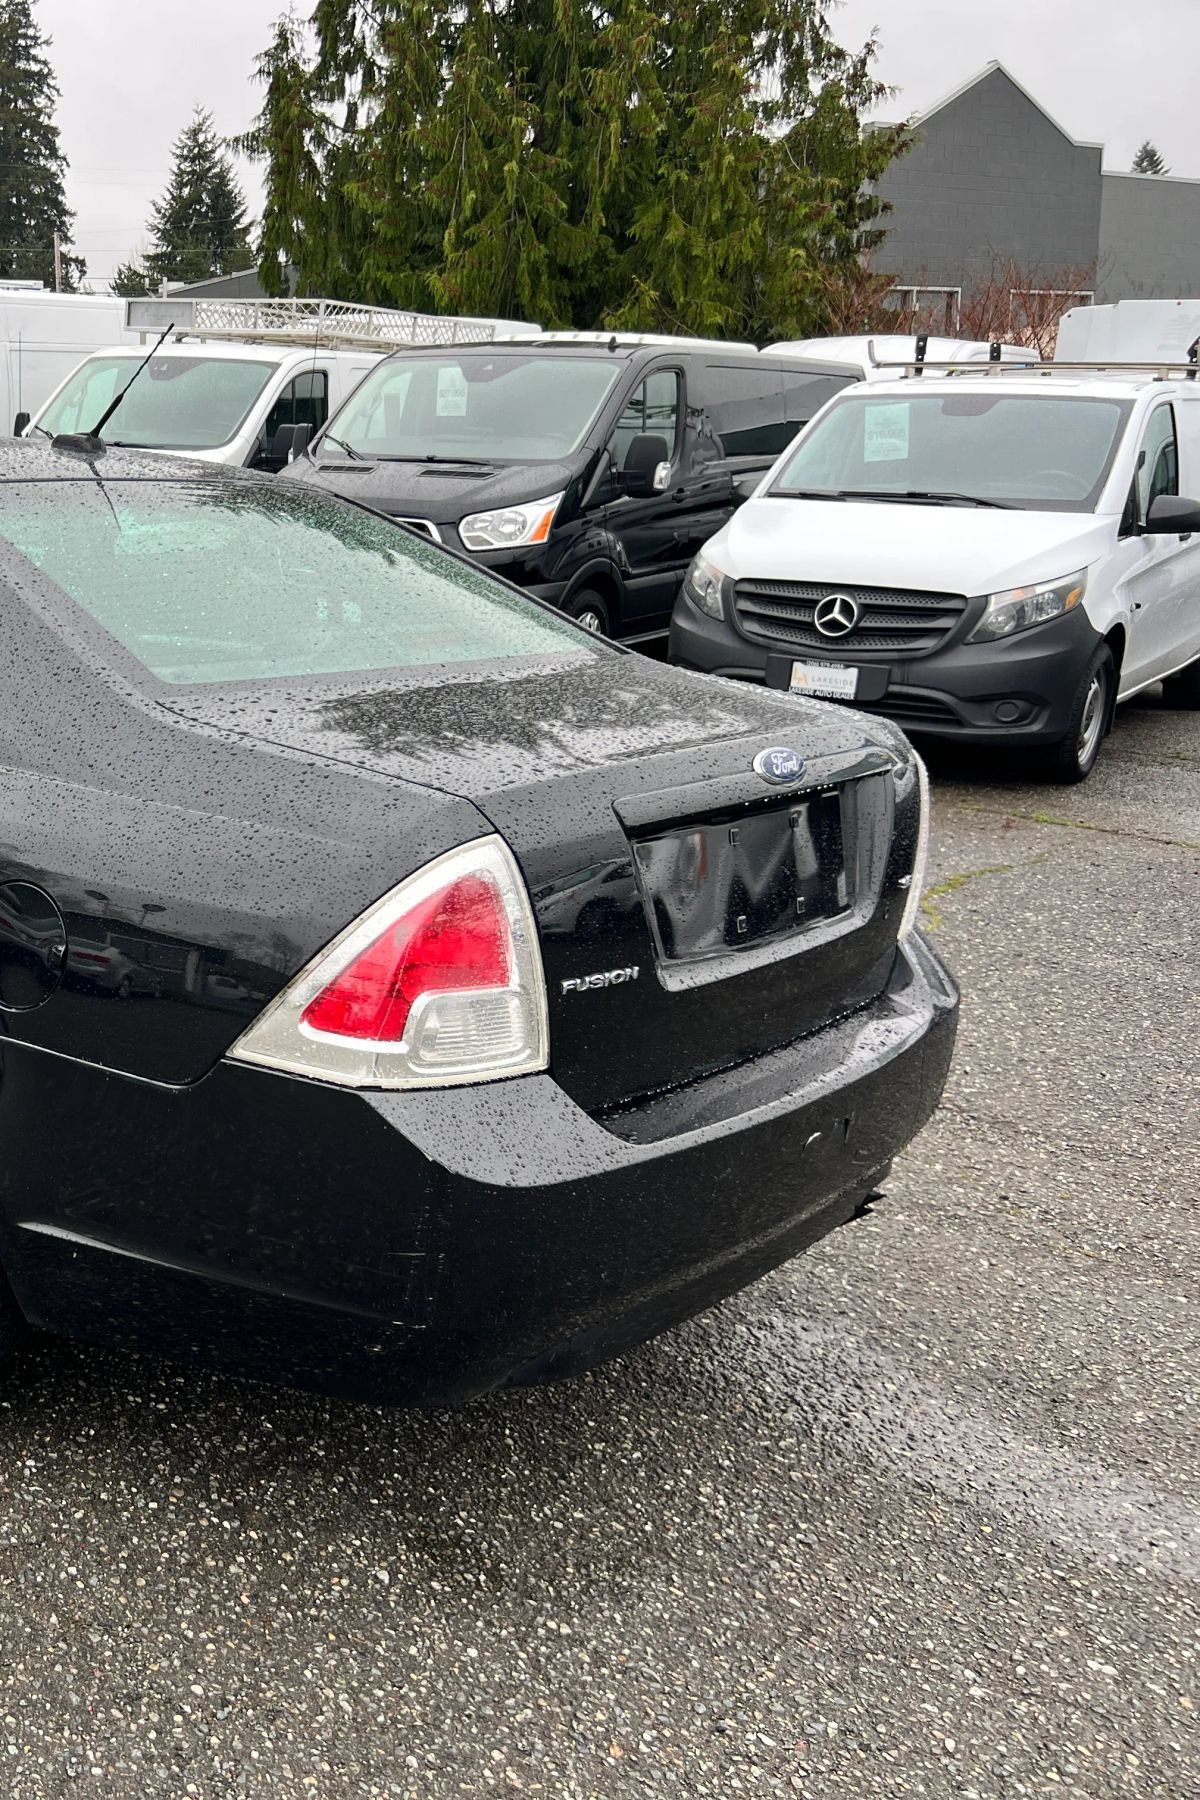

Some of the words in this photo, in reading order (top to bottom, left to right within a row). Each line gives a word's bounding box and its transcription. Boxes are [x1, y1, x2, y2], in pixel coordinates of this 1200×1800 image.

[811, 675, 854, 687] LAKESIDE
[788, 686, 814, 696] LAKESIDE
[815, 689, 832, 698] AUTO
[770, 752, 799, 775] Ford
[561, 966, 640, 995] FUSION
